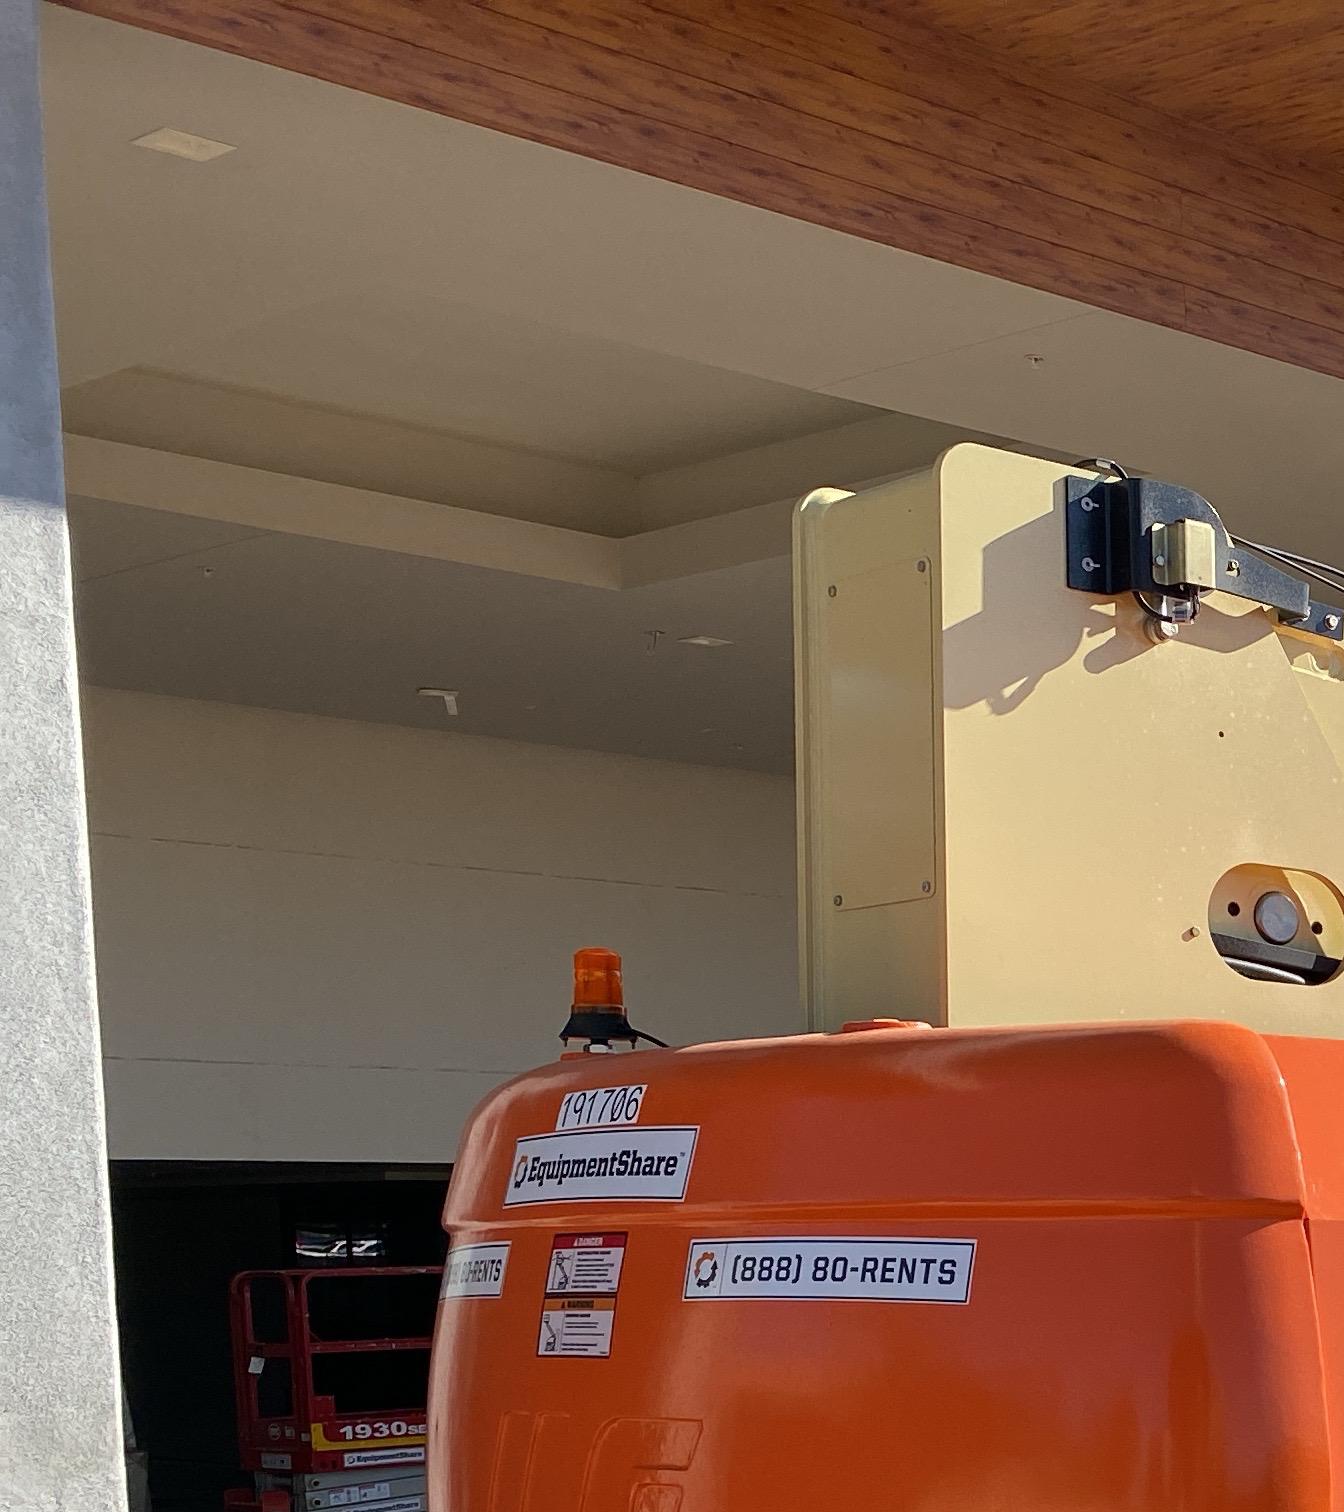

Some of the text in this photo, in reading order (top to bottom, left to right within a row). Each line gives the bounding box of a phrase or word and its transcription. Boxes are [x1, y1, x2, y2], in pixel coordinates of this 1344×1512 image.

[560, 1085, 643, 1128] 191706
[527, 1149, 679, 1186] EquipmentShare
[731, 1253, 958, 1286] (888) 80-RENTS
